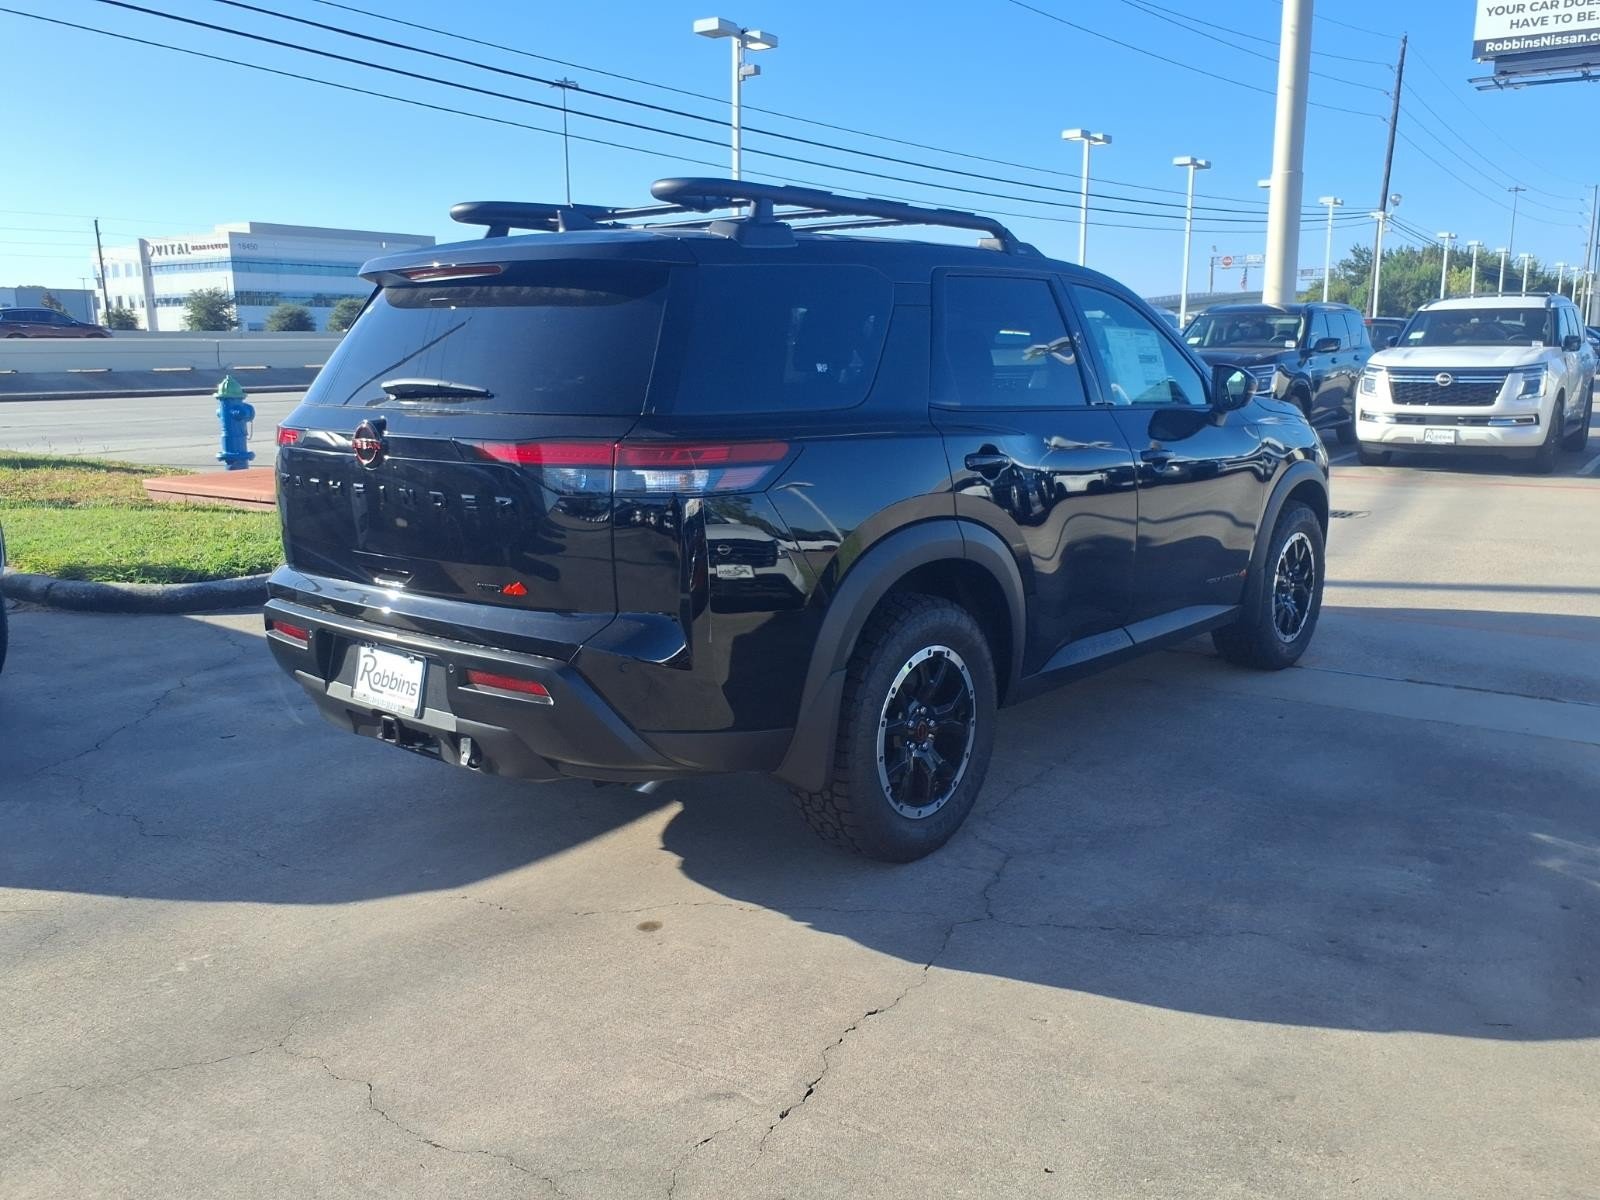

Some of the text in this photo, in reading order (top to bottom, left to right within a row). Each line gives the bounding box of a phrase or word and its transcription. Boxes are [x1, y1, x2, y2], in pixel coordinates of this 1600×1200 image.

[1486, 0, 1600, 17] YOUR CAR DOE
[1509, 10, 1600, 30] HAVE TO BE.
[1485, 32, 1600, 52] RobbinsNissan.c
[155, 242, 192, 256] VITAL
[360, 654, 418, 696] Robbins
